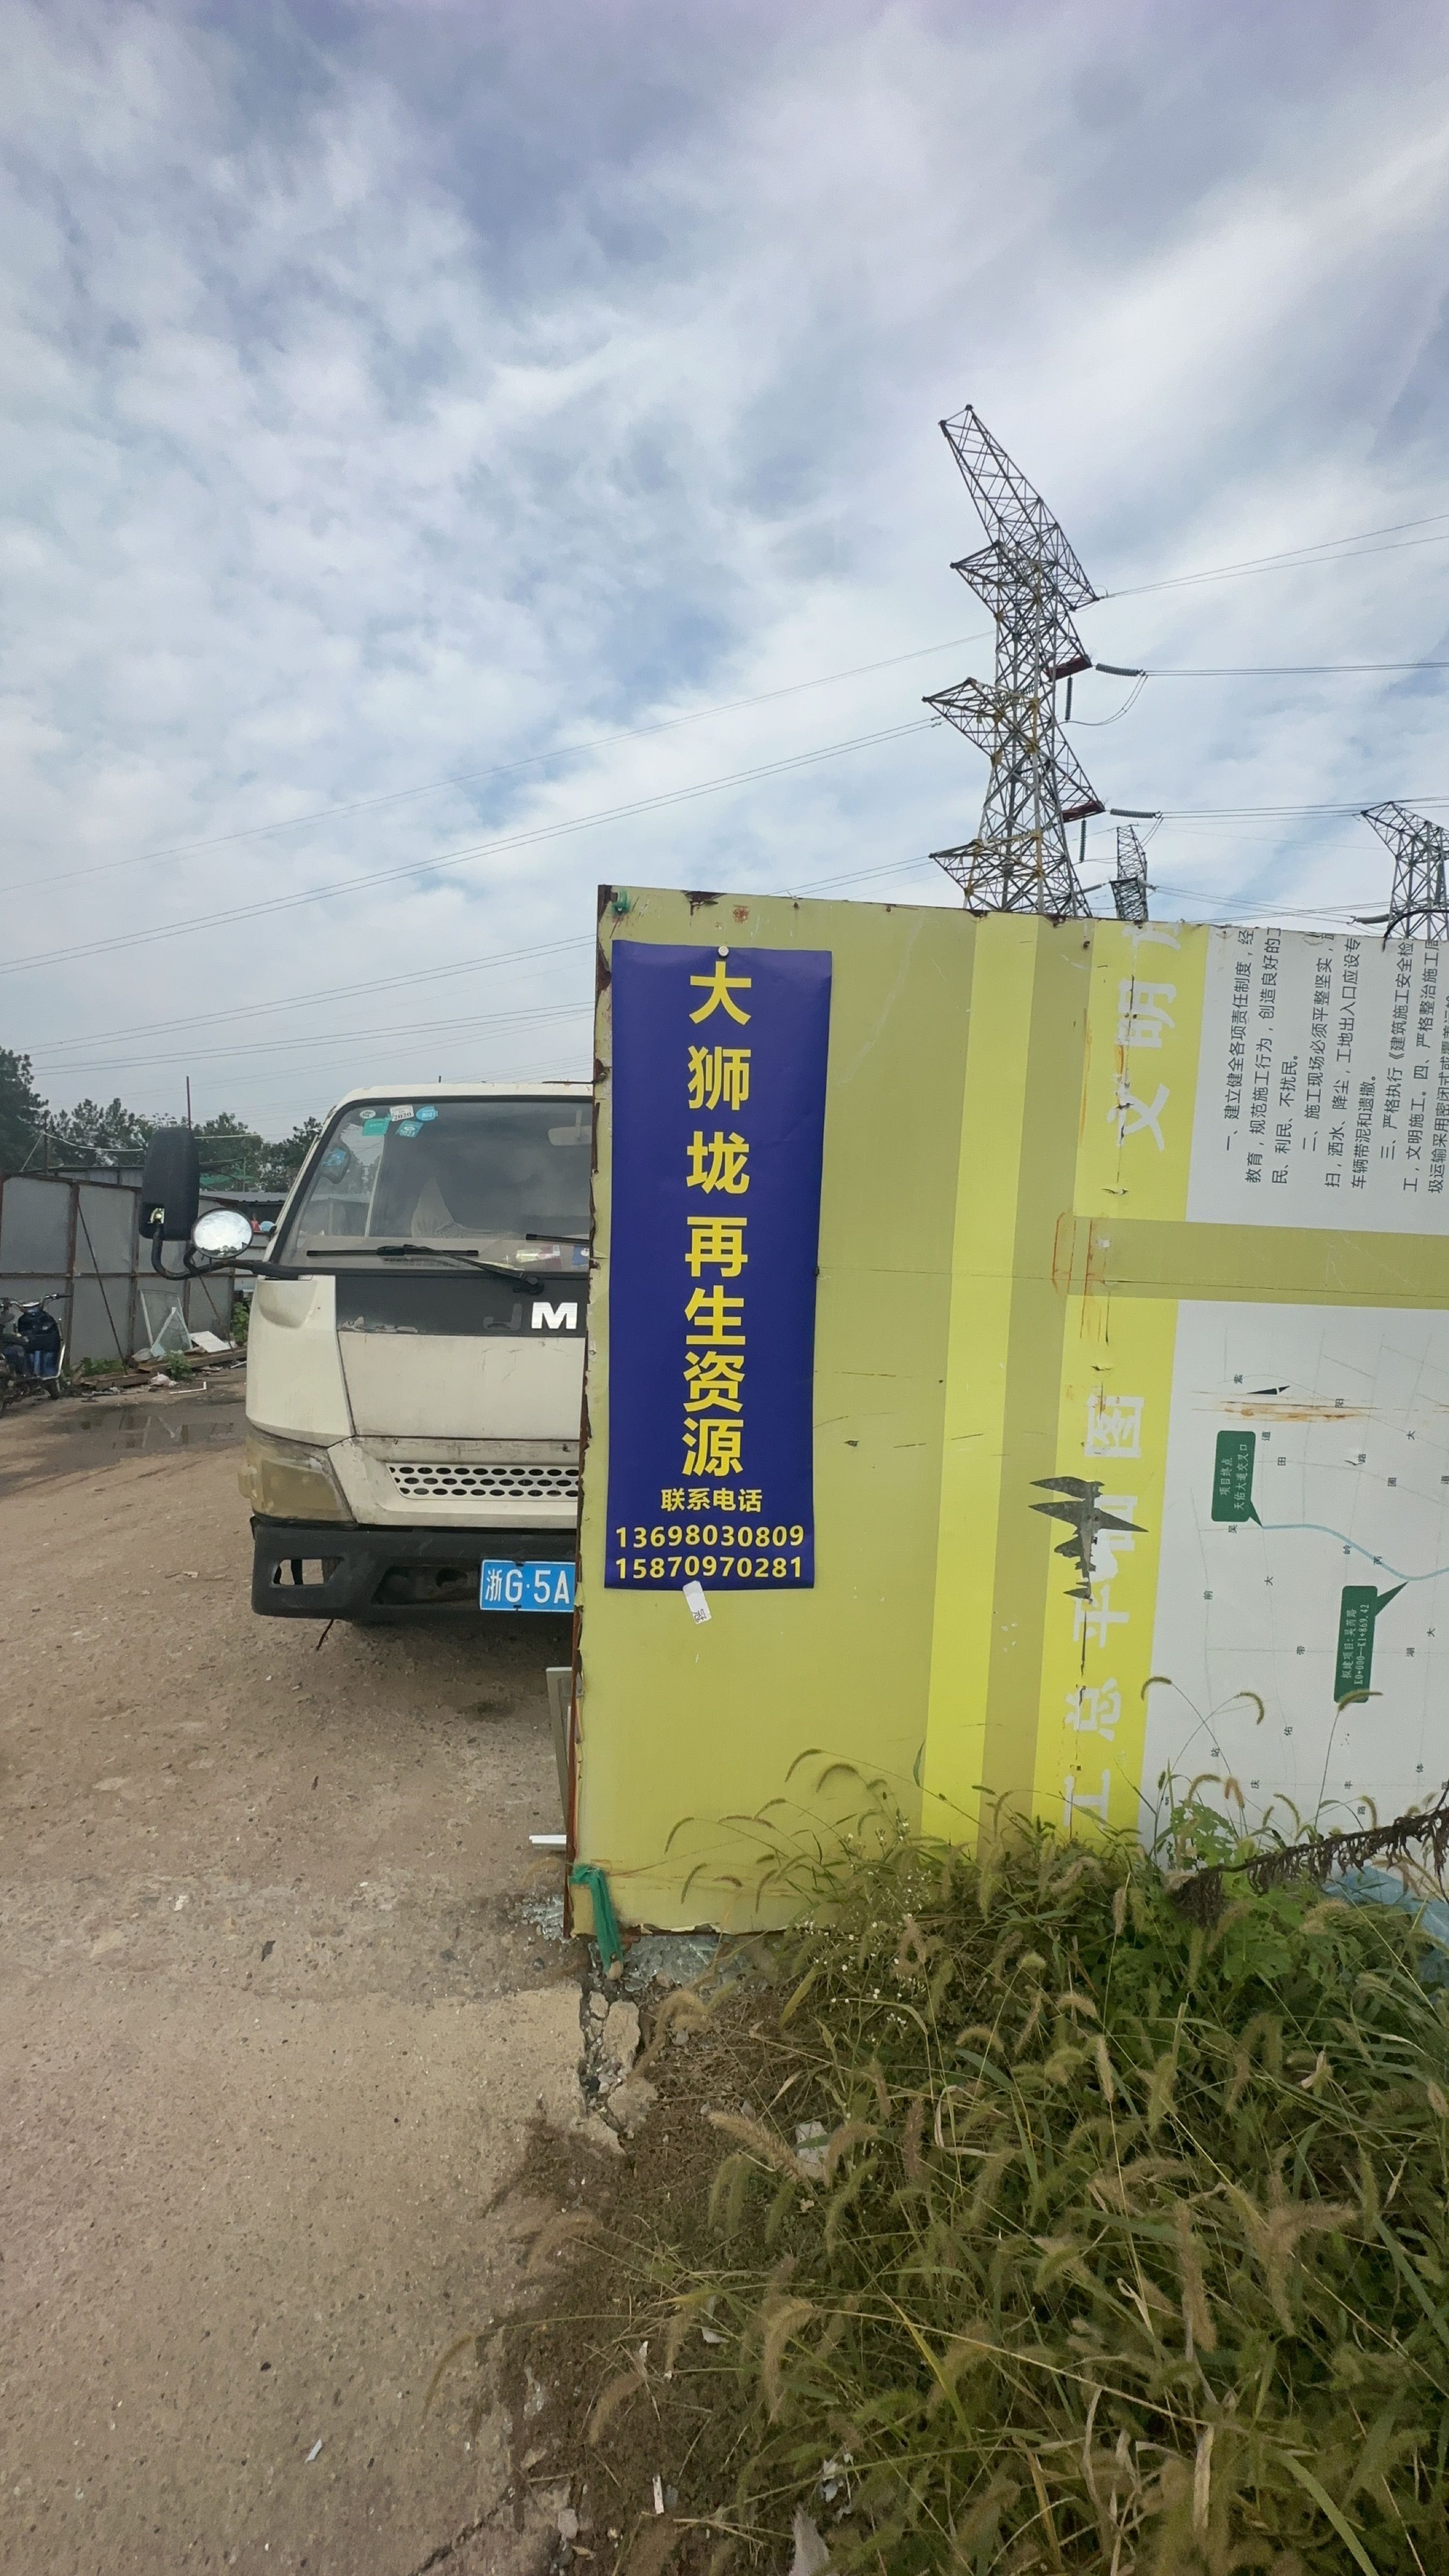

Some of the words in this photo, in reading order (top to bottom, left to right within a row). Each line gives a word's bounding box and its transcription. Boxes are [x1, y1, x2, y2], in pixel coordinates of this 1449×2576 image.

[682, 961, 752, 1477] 大狮垅再生资源
[1406, 1431, 1415, 1440] 大
[1278, 1457, 1286, 1466] 田
[1219, 1457, 1233, 1496] 项目终点
[1234, 1444, 1249, 1510] 天佑大道交叉口
[661, 1488, 762, 1512] 联系电话
[616, 1525, 804, 1548] 13698030809
[616, 1555, 801, 1579] 15870970281
[1264, 1576, 1273, 1586] 大
[1426, 1628, 1435, 1637] 大
